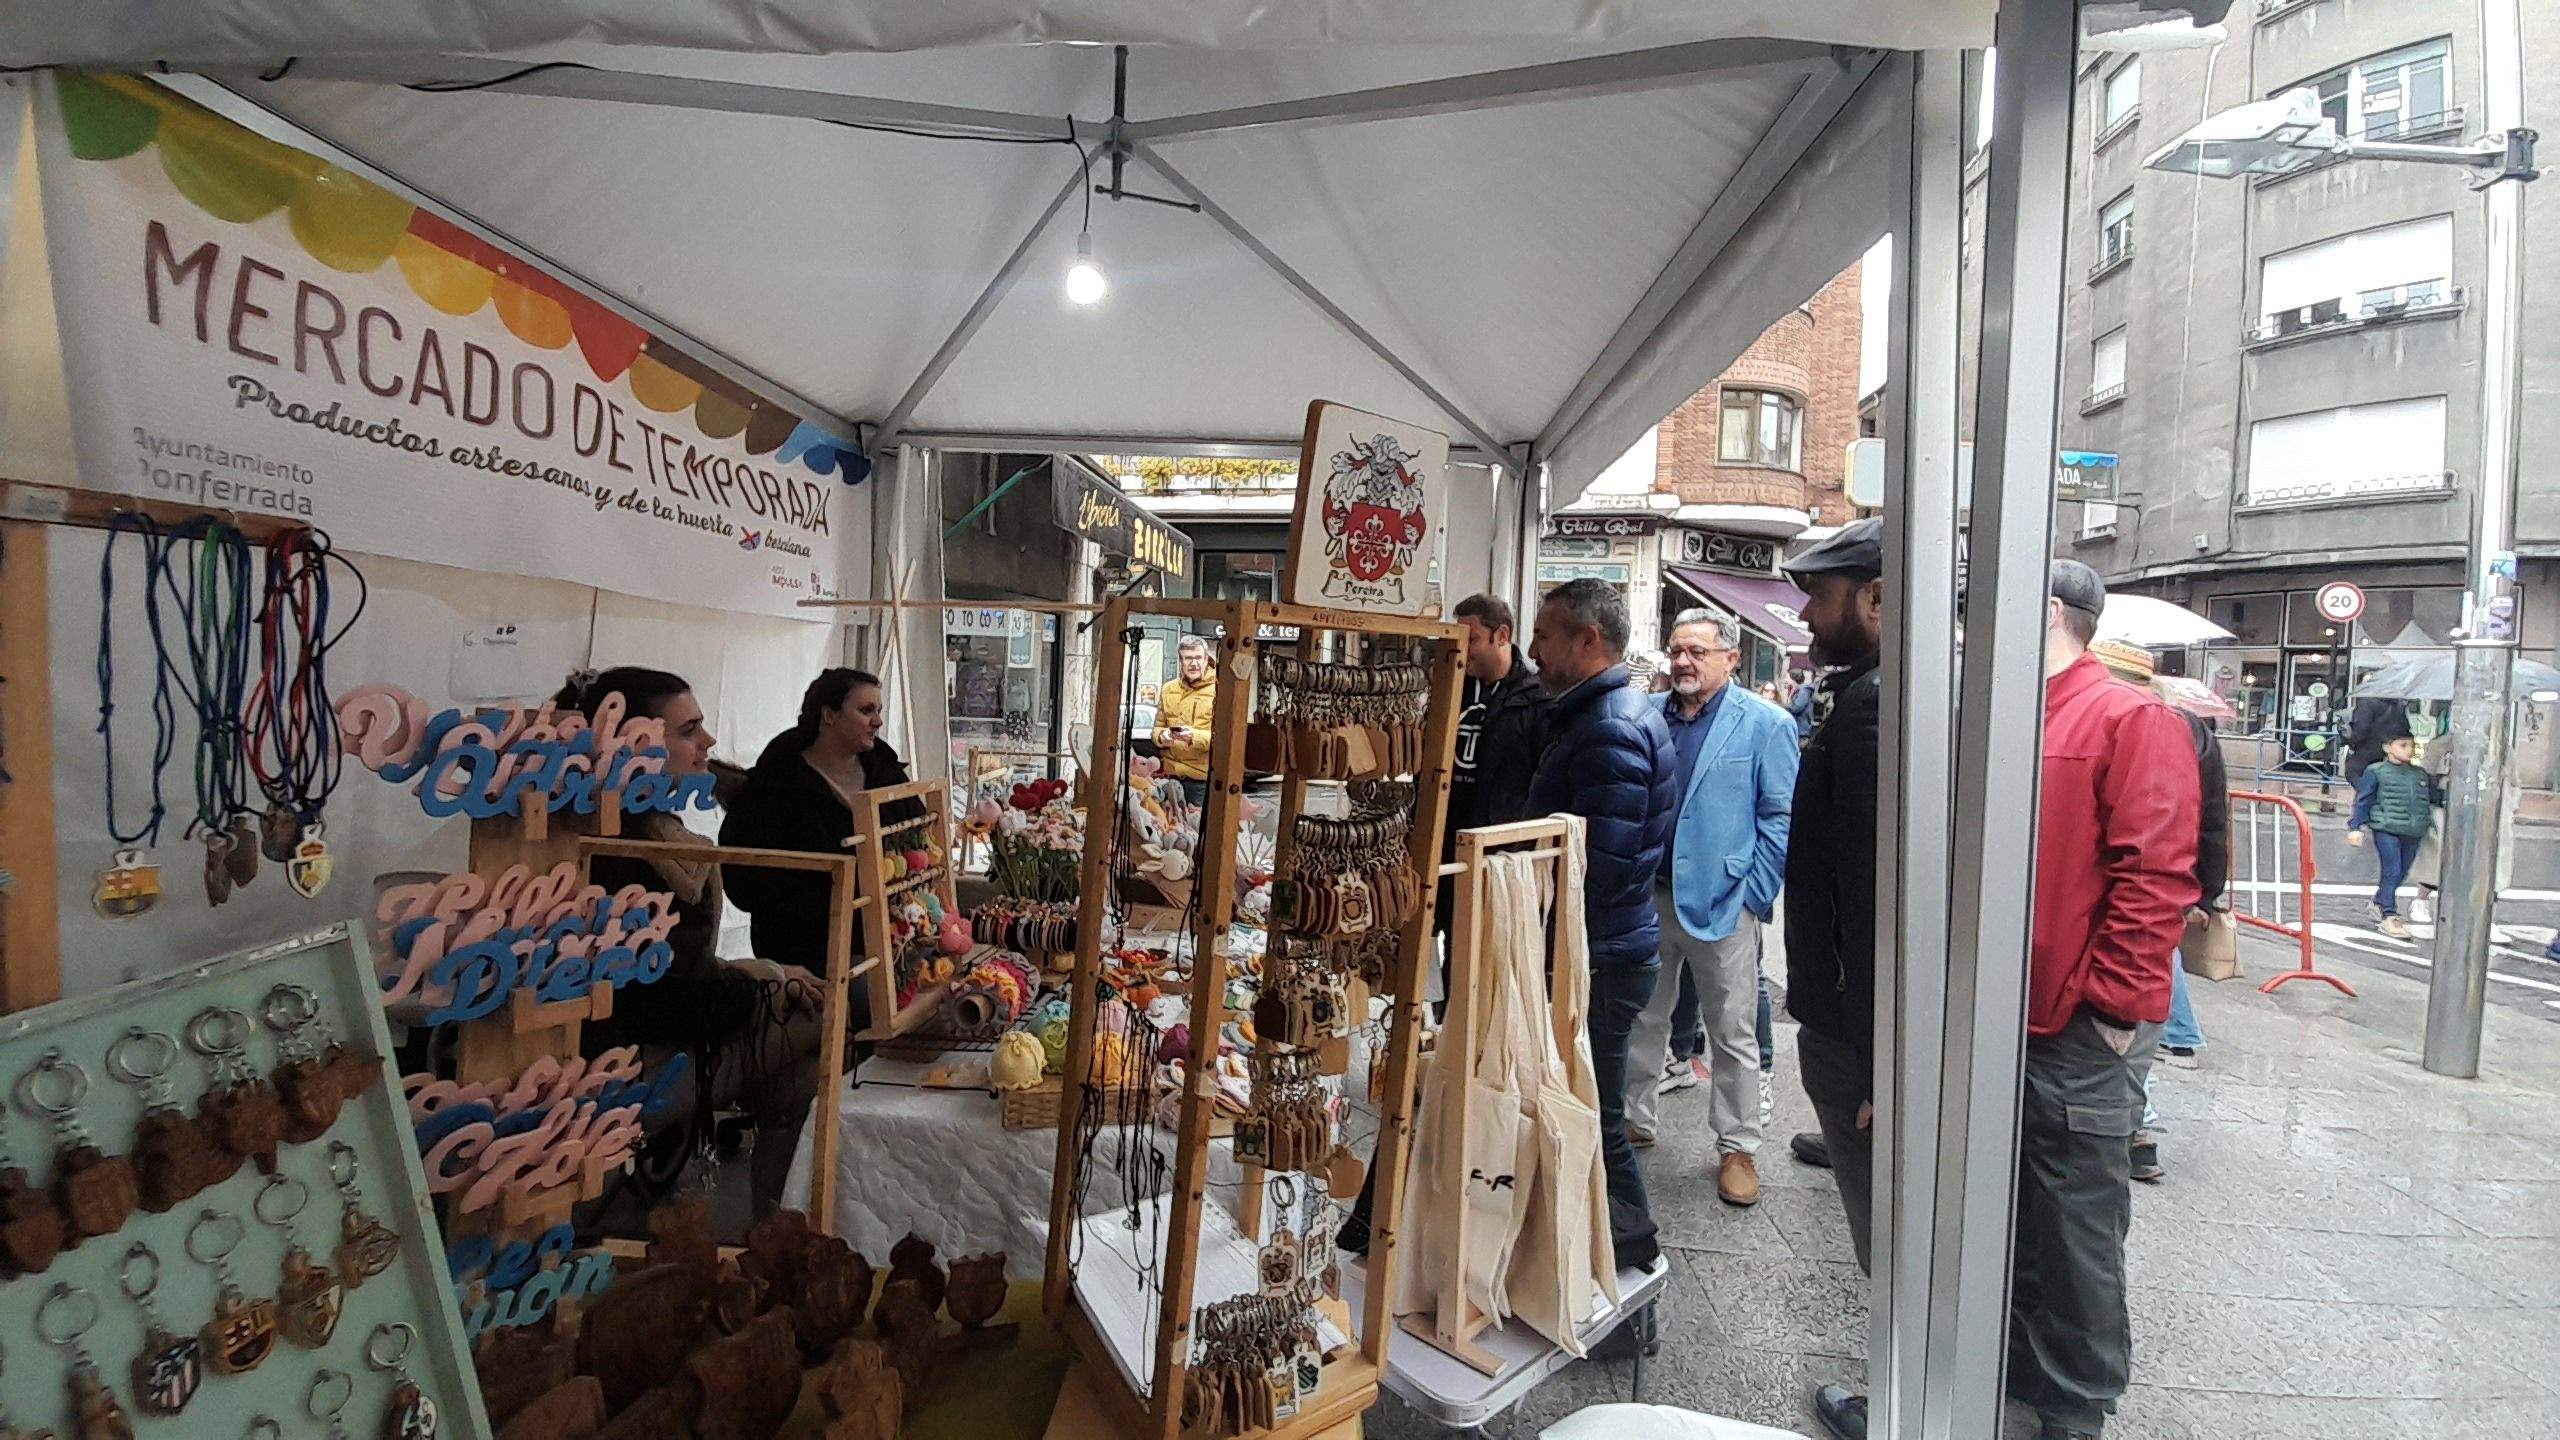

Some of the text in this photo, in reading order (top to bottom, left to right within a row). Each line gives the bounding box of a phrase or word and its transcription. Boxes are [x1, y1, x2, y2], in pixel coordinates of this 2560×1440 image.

[145, 220, 831, 536] MERCADO DE TEMPORADA
[228, 374, 444, 458] Productos
[450, 445, 592, 496] artesanos
[594, 486, 613, 511] y
[617, 489, 649, 514] de
[653, 496, 675, 521] la
[677, 504, 734, 537] huerta
[1345, 580, 1384, 597] Pereira
[2329, 595, 2352, 609] 20
[425, 938, 674, 1027] Diego
